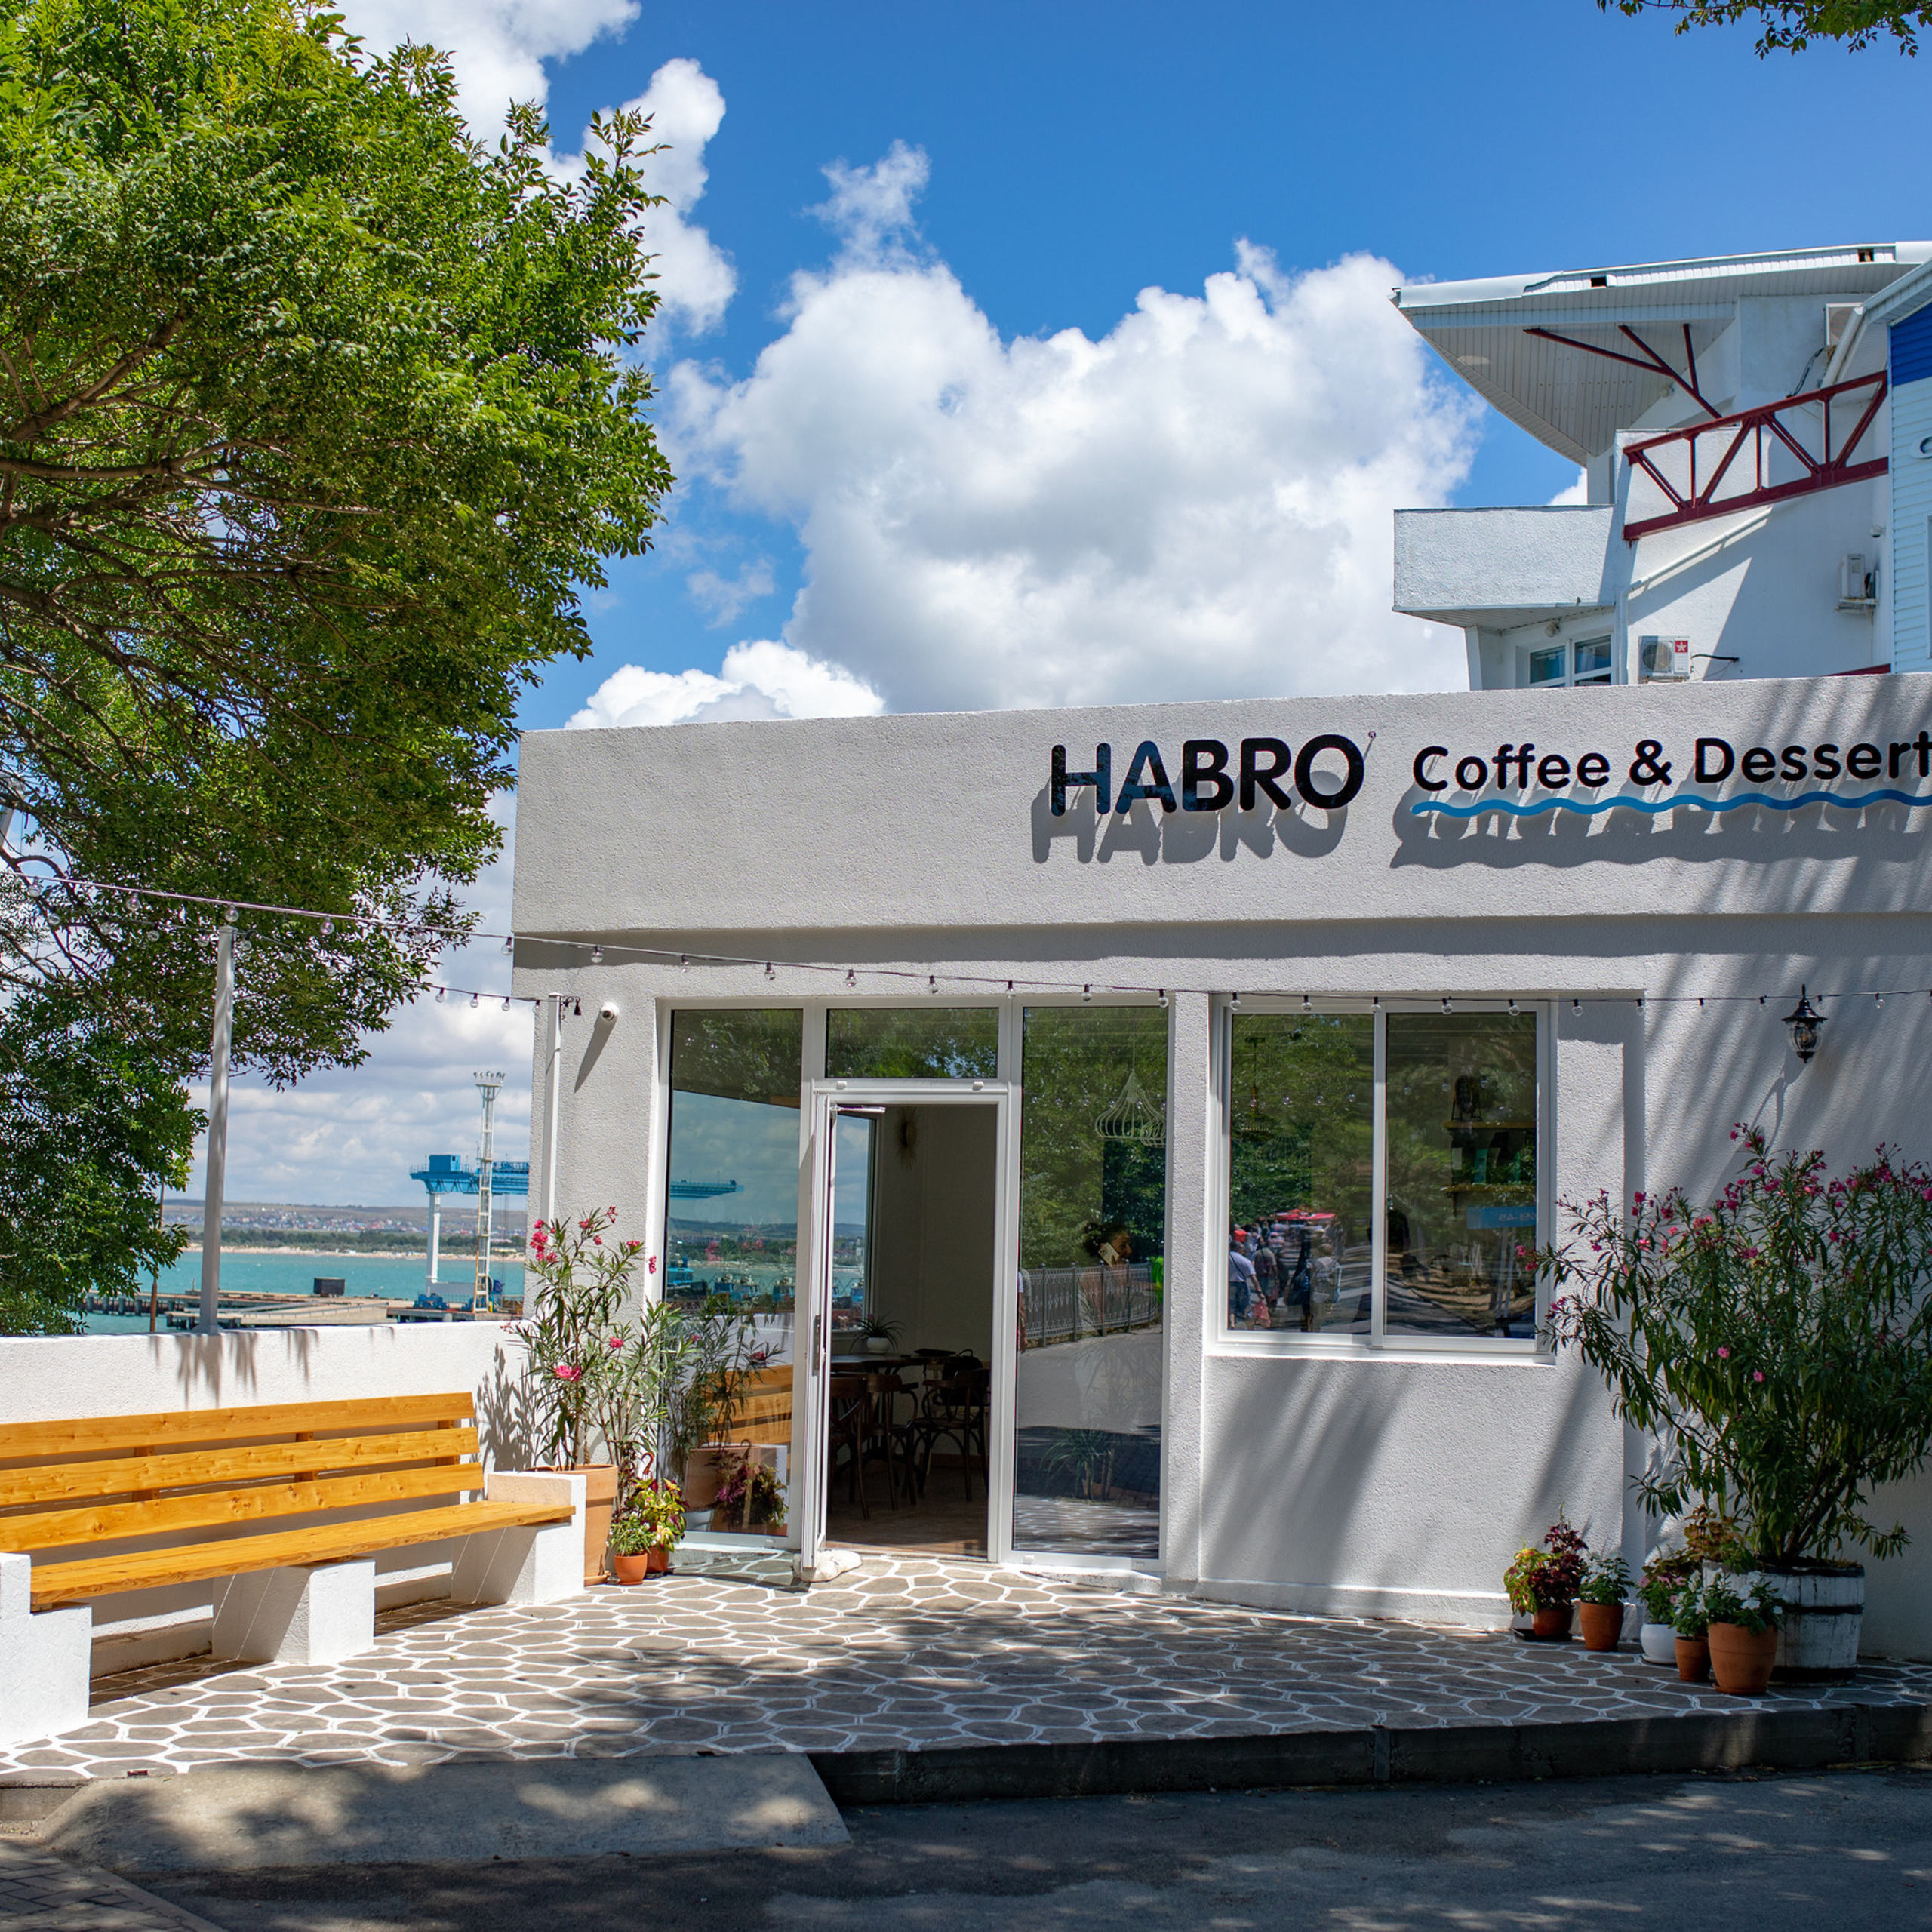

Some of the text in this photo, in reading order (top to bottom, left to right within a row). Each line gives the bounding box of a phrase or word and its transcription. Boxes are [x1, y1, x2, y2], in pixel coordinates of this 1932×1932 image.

[1051, 731, 1932, 817] HABRO Coffee & Dessert
